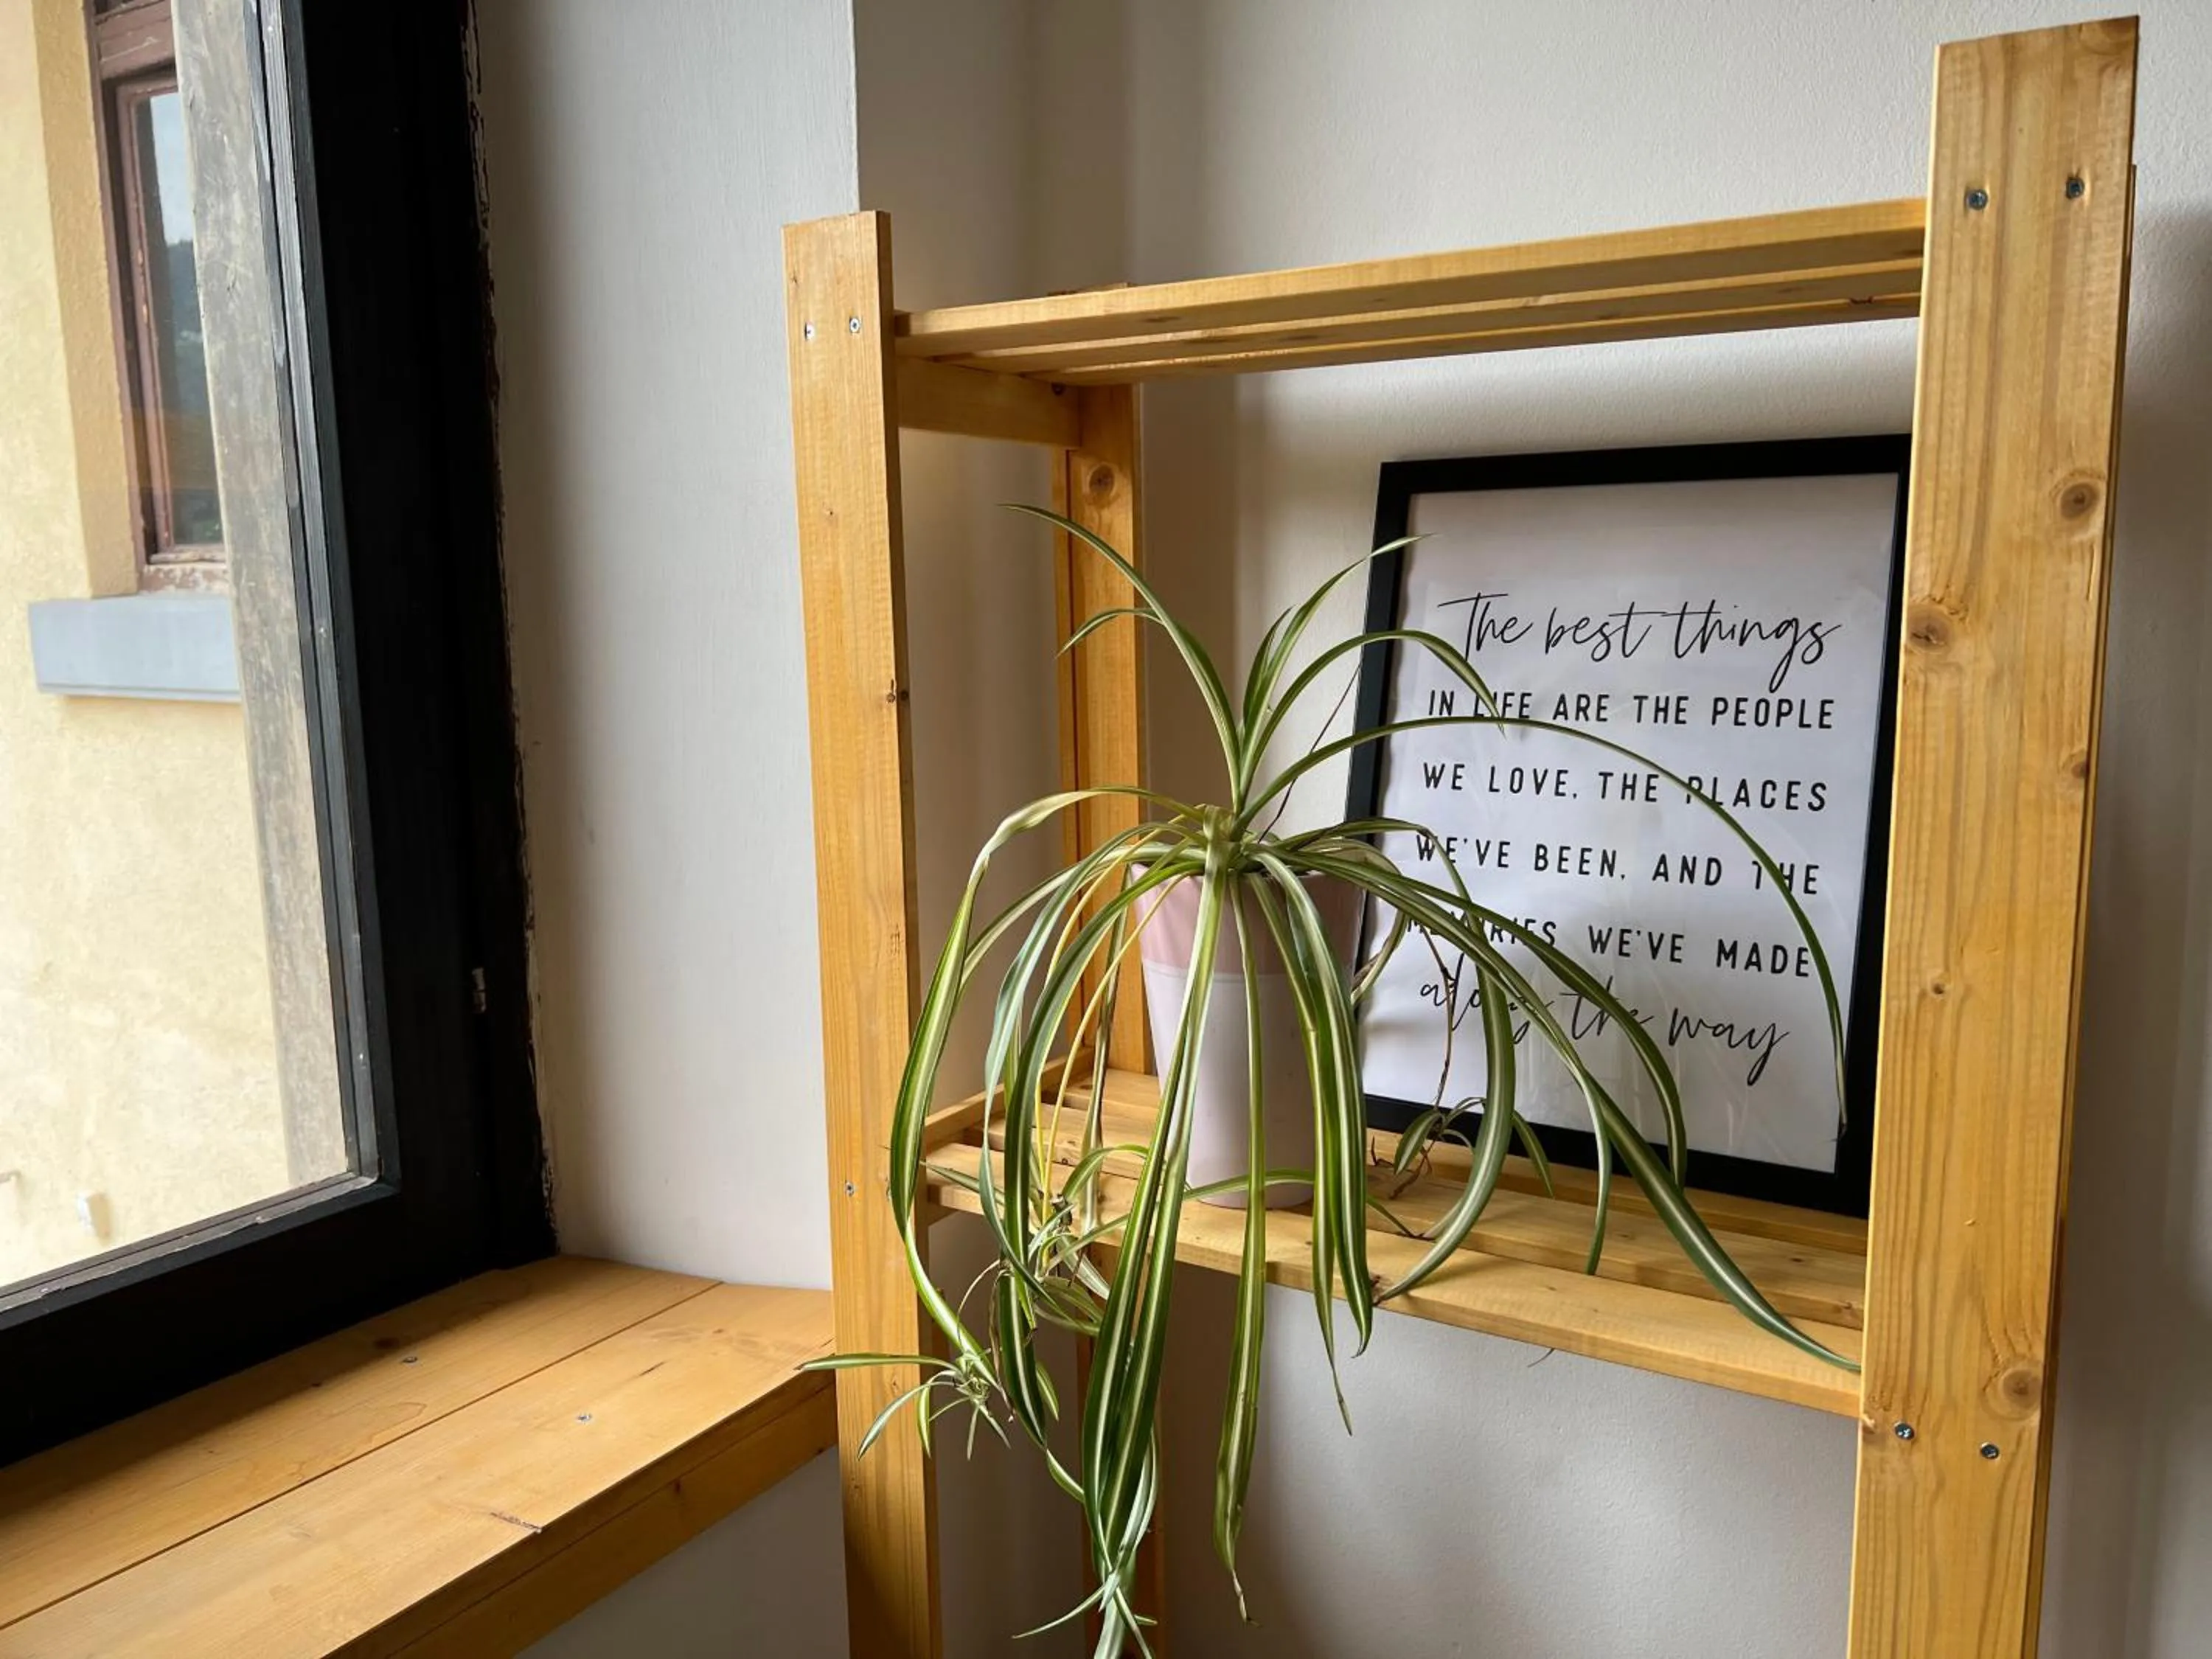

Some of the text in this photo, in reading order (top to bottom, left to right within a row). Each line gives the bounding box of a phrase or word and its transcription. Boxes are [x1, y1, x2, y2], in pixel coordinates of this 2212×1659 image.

[1437, 592, 1842, 694] The best things
[1428, 689, 1455, 717] IN
[1552, 693, 1610, 722] ARE
[1633, 695, 1689, 725] THE
[1711, 697, 1834, 729] PEOPLE
[1424, 762, 1465, 790] WE
[1598, 771, 1659, 803] THE
[1686, 776, 1827, 812] PLACES
[1416, 834, 1511, 868] WE'VE
[1652, 853, 1722, 886] AND
[1751, 860, 1820, 895] THE
[1588, 925, 1685, 964] WE'VE
[1716, 938, 1809, 978] MADE
[1667, 1006, 1791, 1087] way
